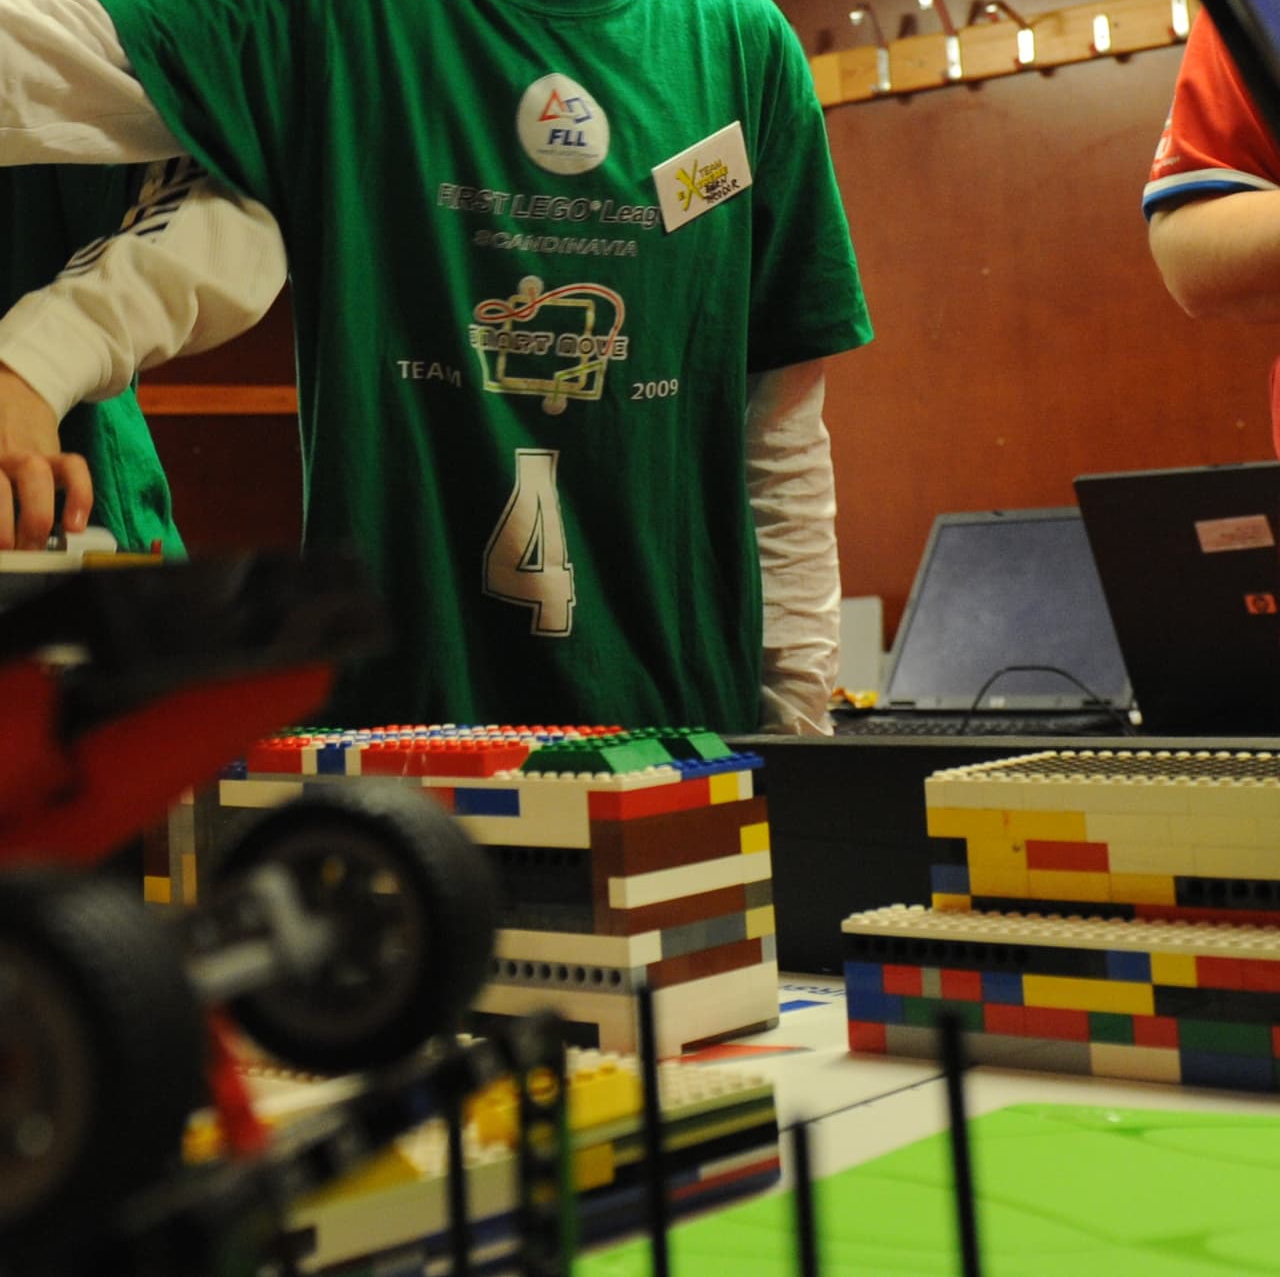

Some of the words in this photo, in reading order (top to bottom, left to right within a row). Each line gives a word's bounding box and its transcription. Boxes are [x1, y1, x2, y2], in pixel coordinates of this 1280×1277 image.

[548, 128, 587, 147] FLL
[436, 182, 511, 216] FIRST
[473, 230, 639, 257] SCANDINAVIA
[555, 333, 629, 360] MOVE
[397, 360, 462, 387] TEAM
[631, 378, 679, 400] 2009
[482, 448, 577, 637] 4
